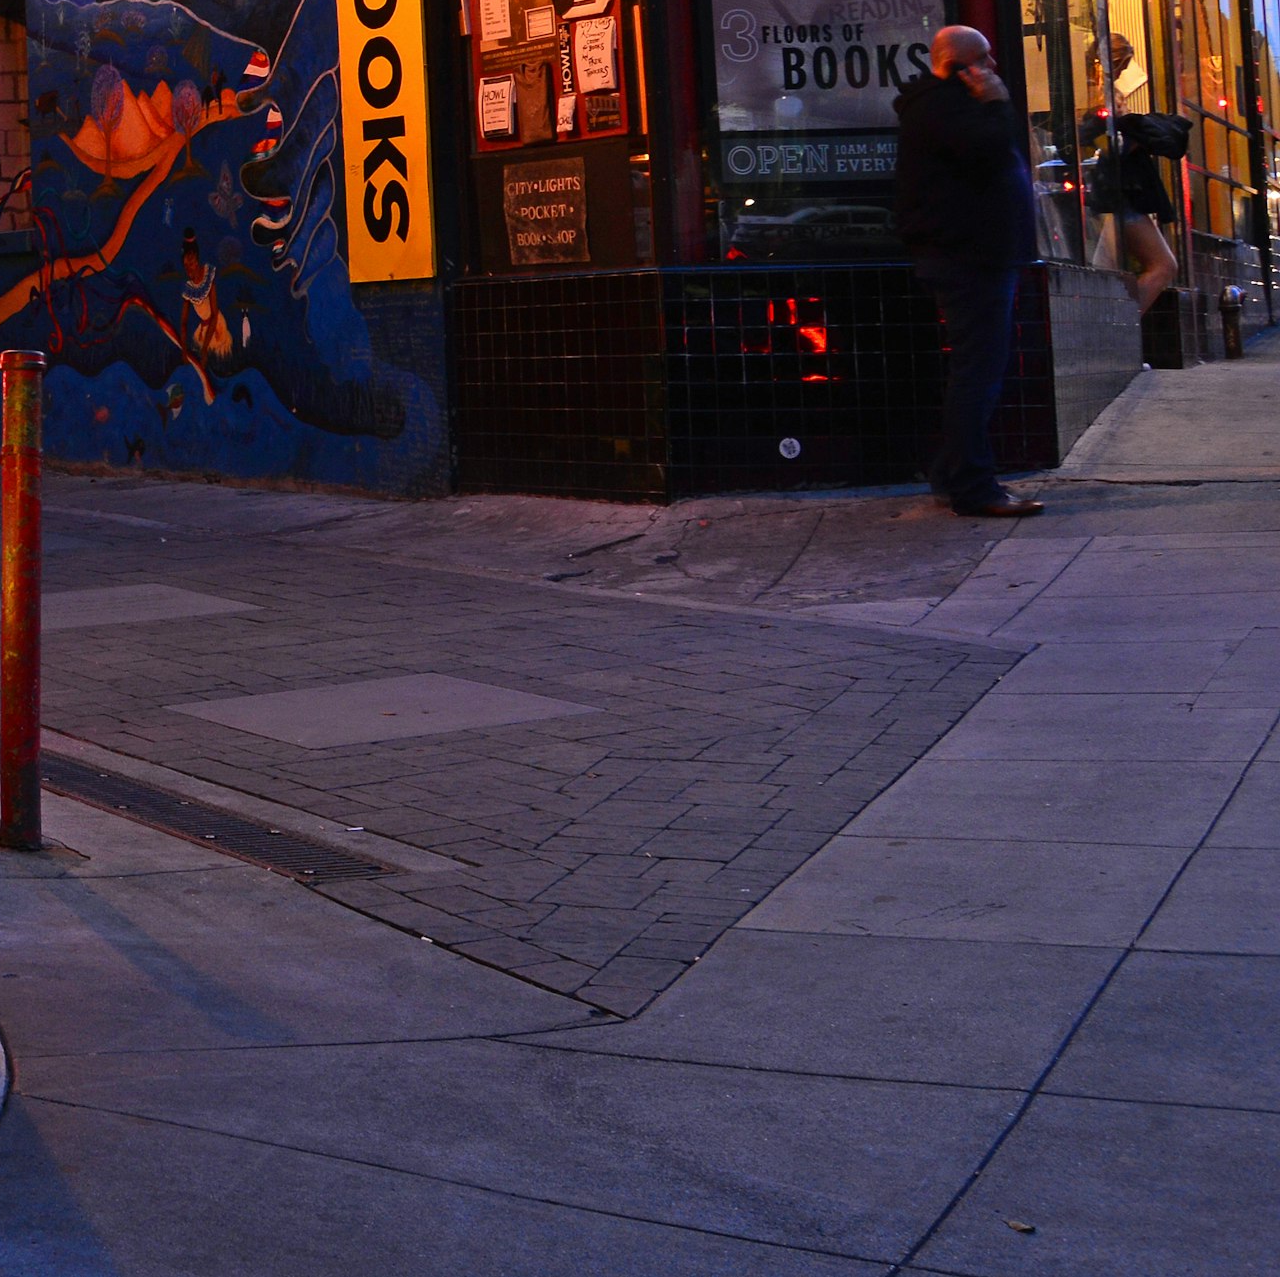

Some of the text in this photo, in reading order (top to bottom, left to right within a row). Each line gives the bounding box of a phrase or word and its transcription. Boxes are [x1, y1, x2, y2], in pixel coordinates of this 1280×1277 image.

[720, 9, 865, 63] 3 FLOORS OF
[561, 45, 573, 93] HOWL
[782, 43, 932, 91] BOOKS
[484, 88, 506, 102] HOWL
[727, 144, 830, 176] OPEN
[520, 204, 567, 220] POCKET
